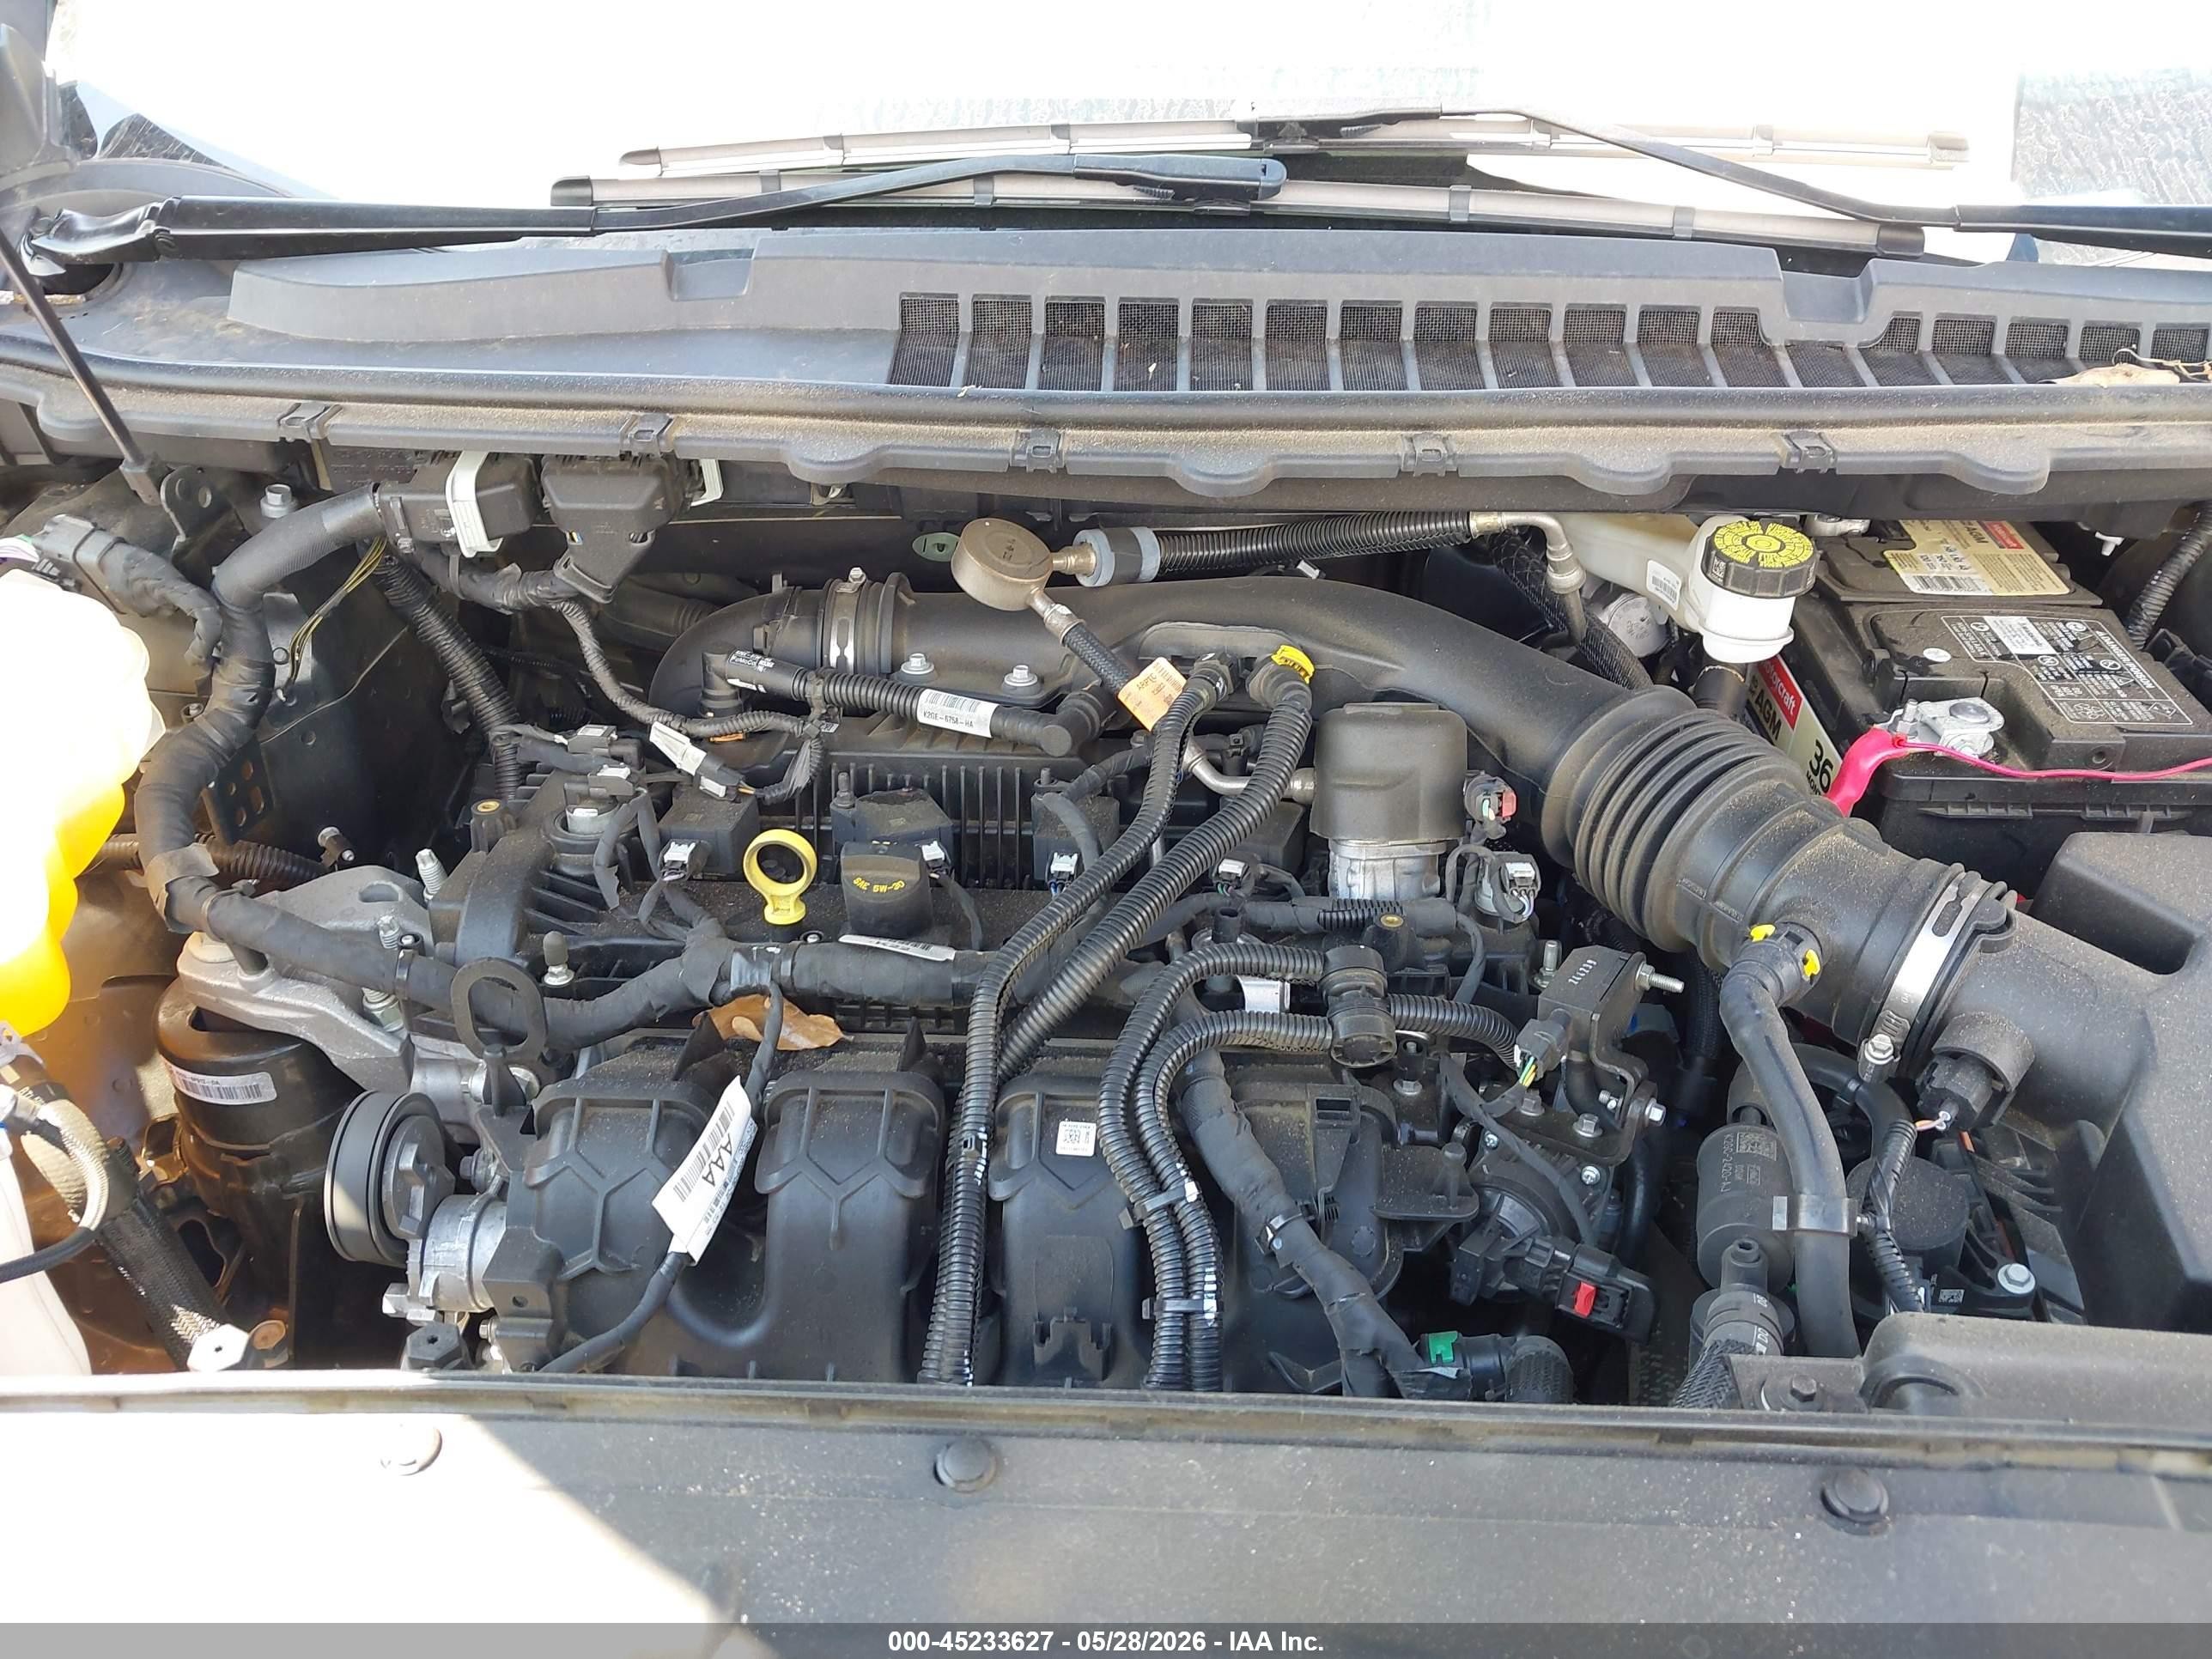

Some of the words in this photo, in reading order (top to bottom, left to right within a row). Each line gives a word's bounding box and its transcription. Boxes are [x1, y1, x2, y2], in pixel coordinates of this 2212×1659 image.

[1764, 660, 1796, 714] otorcraft
[1754, 690, 1782, 740] AGM
[1808, 739, 1833, 793] 36
[853, 877, 871, 890] SAE
[702, 1133, 732, 1187] AAA
